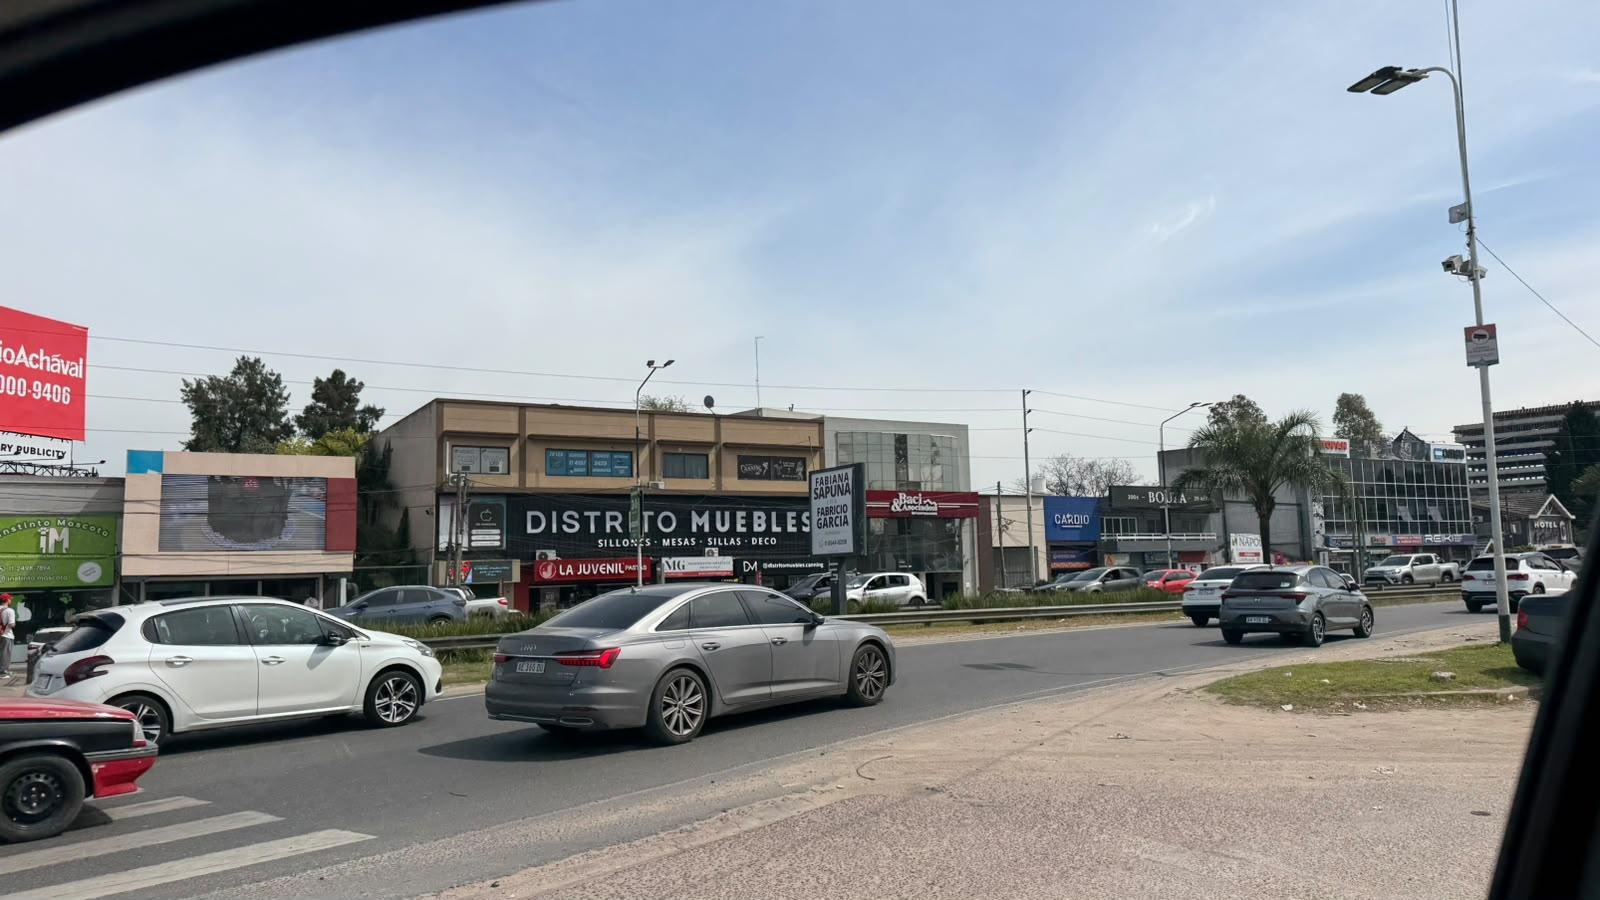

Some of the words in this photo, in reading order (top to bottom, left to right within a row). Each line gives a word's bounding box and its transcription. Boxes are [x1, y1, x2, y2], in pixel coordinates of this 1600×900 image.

[815, 472, 849, 487] FABIANA
[813, 482, 851, 500] SAPUNA
[817, 504, 848, 517] FABRICIO
[691, 510, 810, 533] MUEBLES
[816, 514, 849, 529] GARCIA
[1534, 521, 1558, 529] HOTEL
[662, 537, 696, 546] MESAS
[707, 537, 741, 545] SILLAS
[751, 537, 777, 545] DECO
[559, 563, 574, 576] LA
[577, 562, 625, 576] JUVENIL
